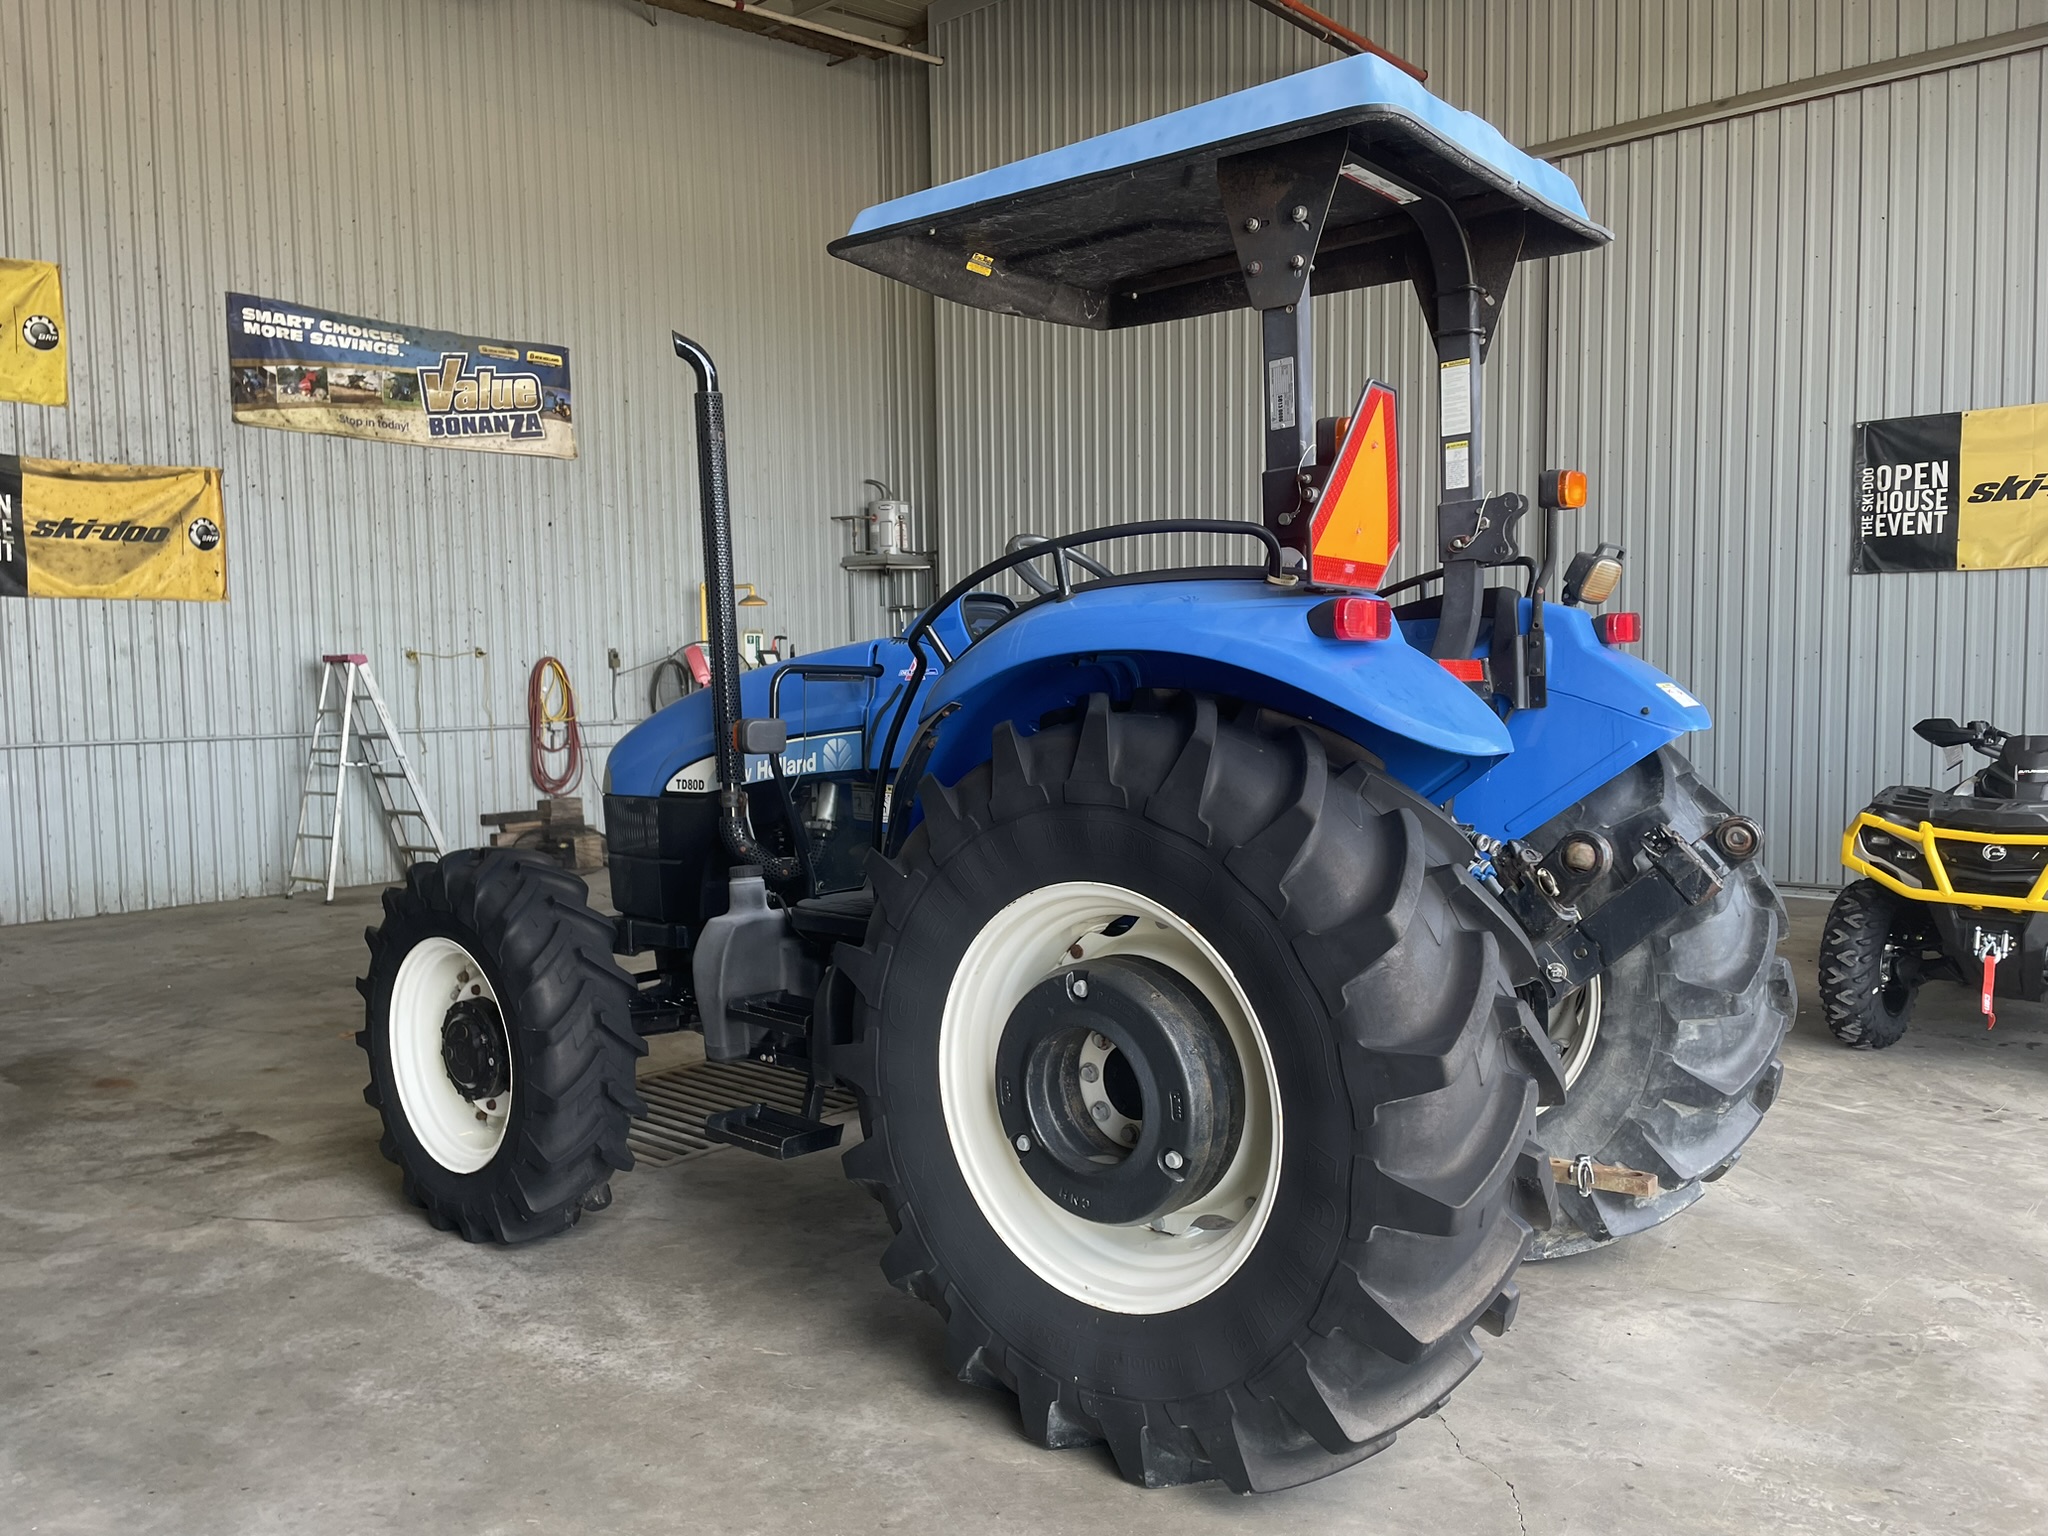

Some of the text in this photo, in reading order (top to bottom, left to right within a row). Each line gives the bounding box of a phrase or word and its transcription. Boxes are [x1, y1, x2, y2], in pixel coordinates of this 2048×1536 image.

[242, 307, 411, 345] SMART CHOICES.
[243, 321, 404, 357] MORE SAVINGS.
[423, 358, 538, 412] Value
[339, 414, 410, 432] Stop in today!
[429, 412, 544, 439] BONANZA
[1876, 460, 1949, 492] OPEN
[1967, 473, 2048, 503] ski-
[1861, 467, 1875, 538] THE SKI-DOO
[1875, 488, 1948, 514] HOUSE
[30, 517, 171, 543] ski-doo
[1875, 510, 1948, 537] EVENT
[676, 778, 705, 790] TD80D
